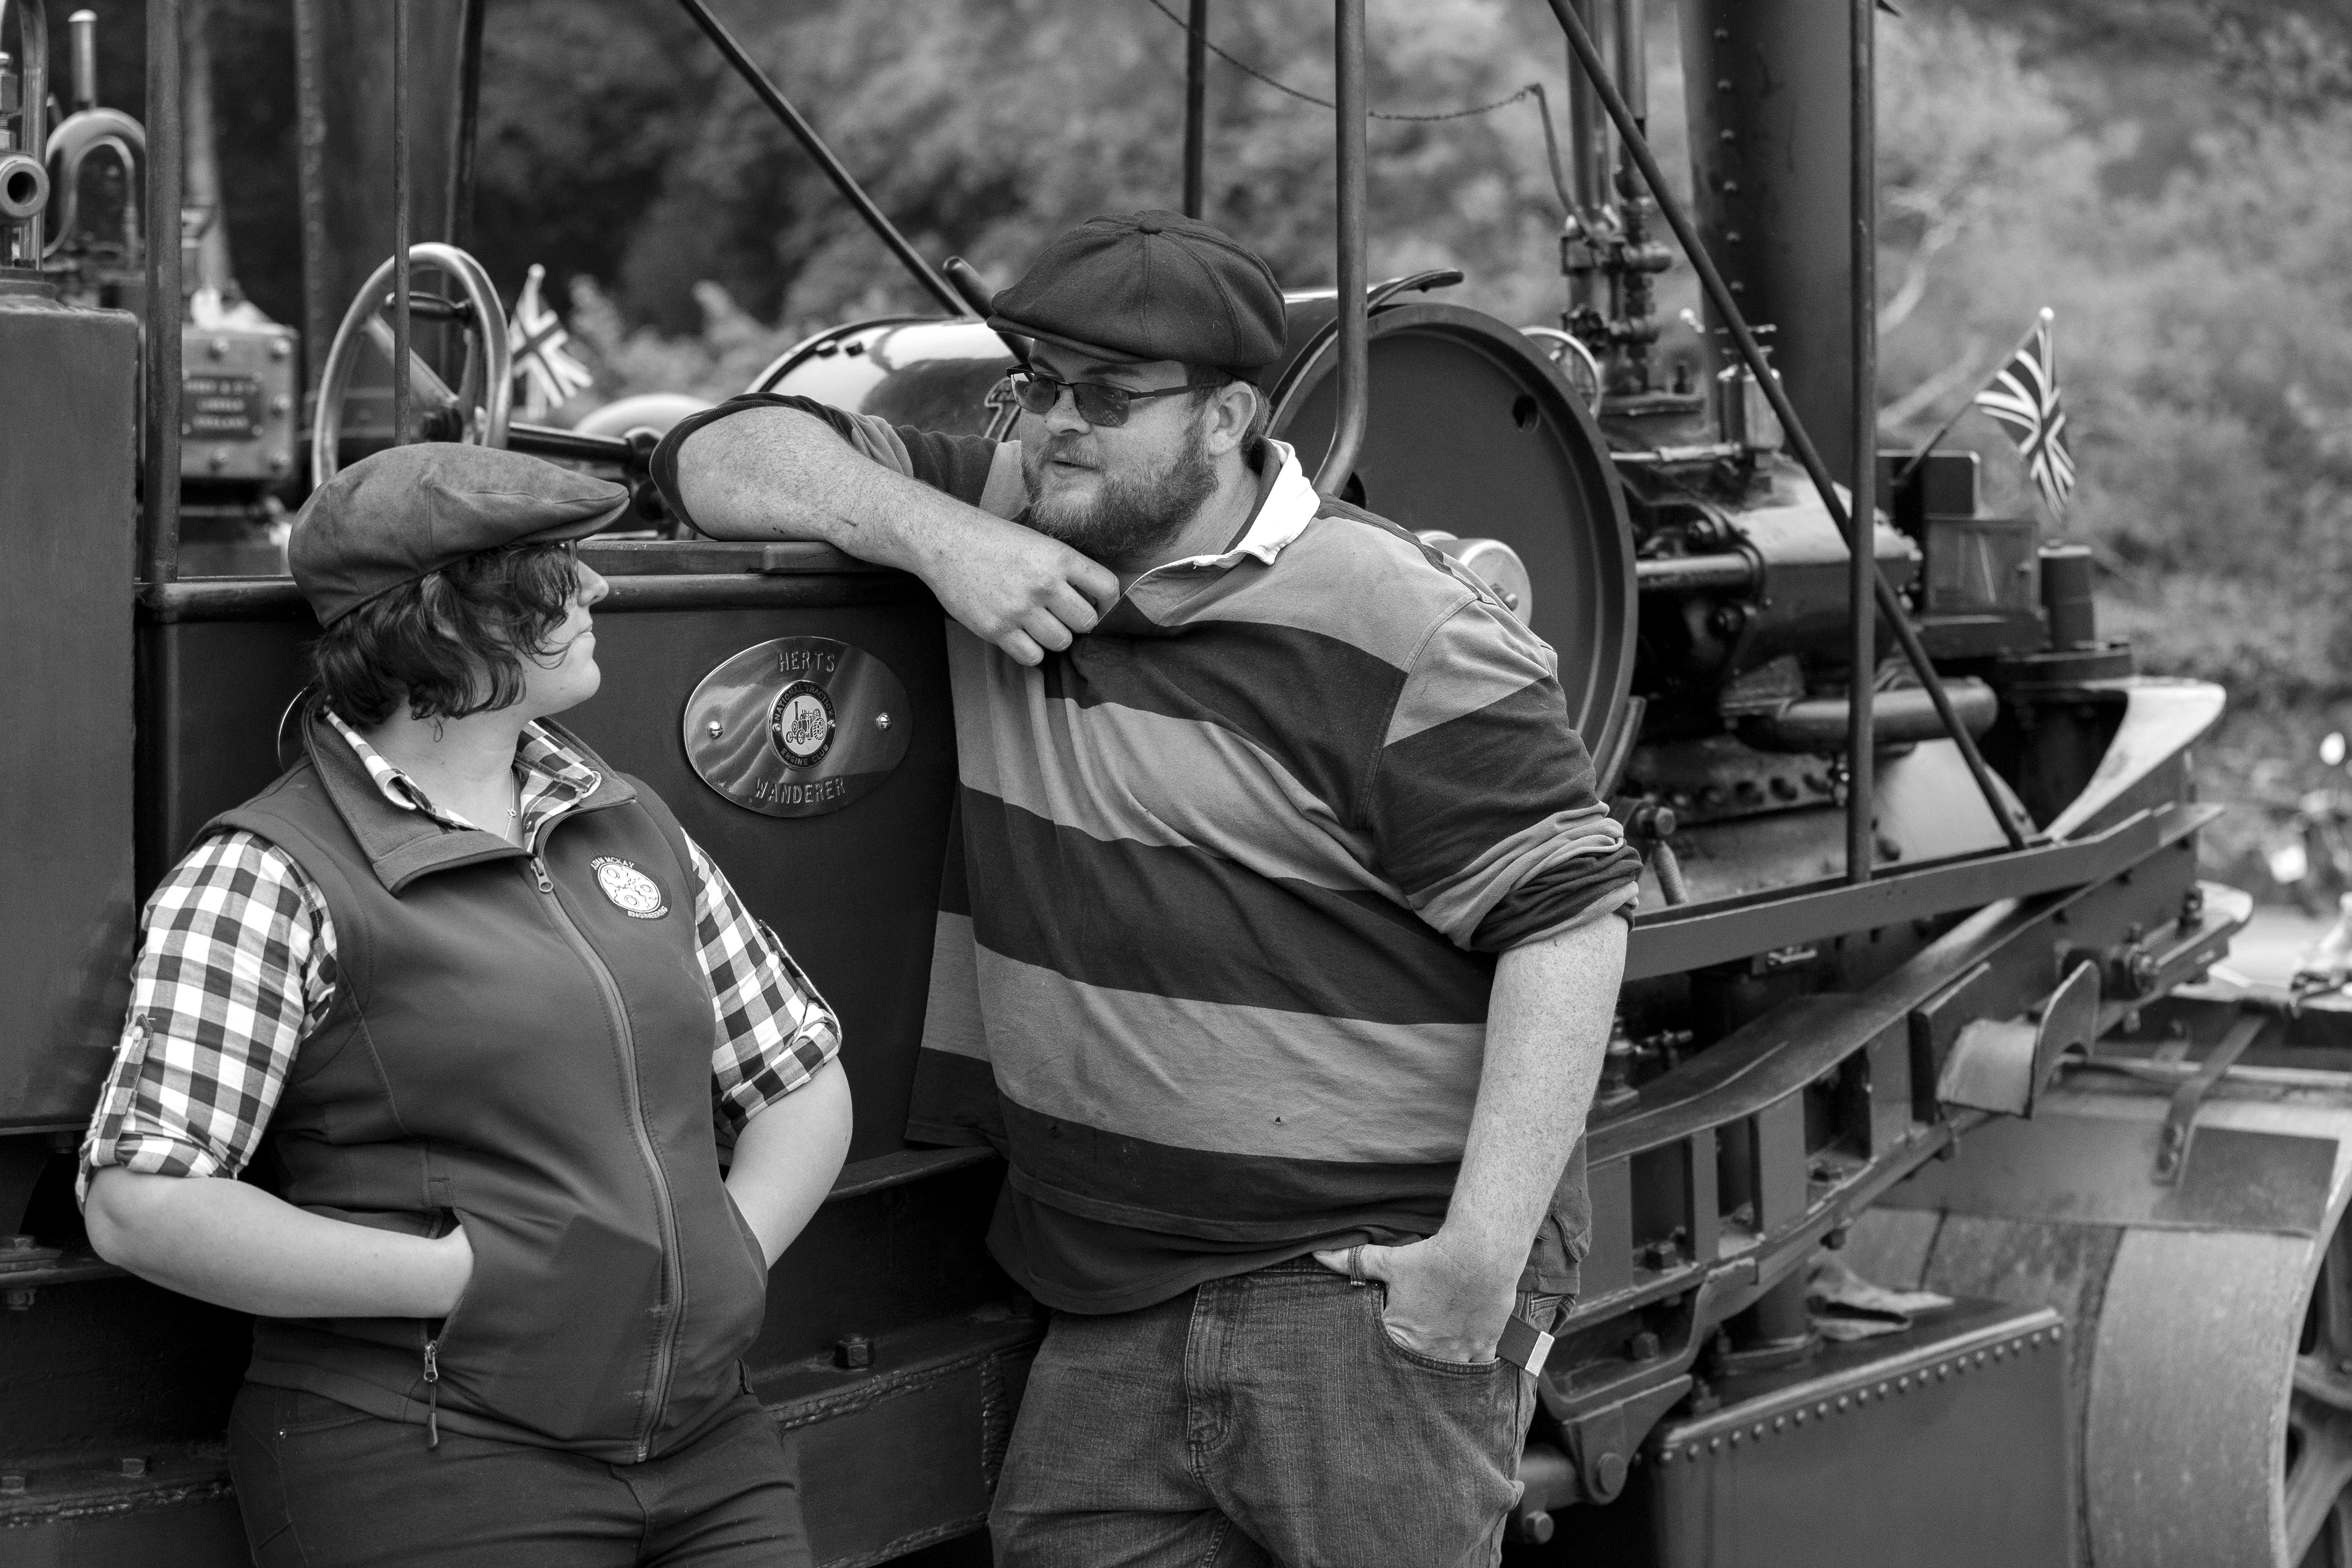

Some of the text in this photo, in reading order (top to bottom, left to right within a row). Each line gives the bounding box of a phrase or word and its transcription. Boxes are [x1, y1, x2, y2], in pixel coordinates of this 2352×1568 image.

[777, 650, 835, 673] HERTS
[774, 684, 833, 721] NATIONAL TRACTION
[781, 744, 829, 765] ENGINE CLUB
[755, 777, 846, 804] WANDERER
